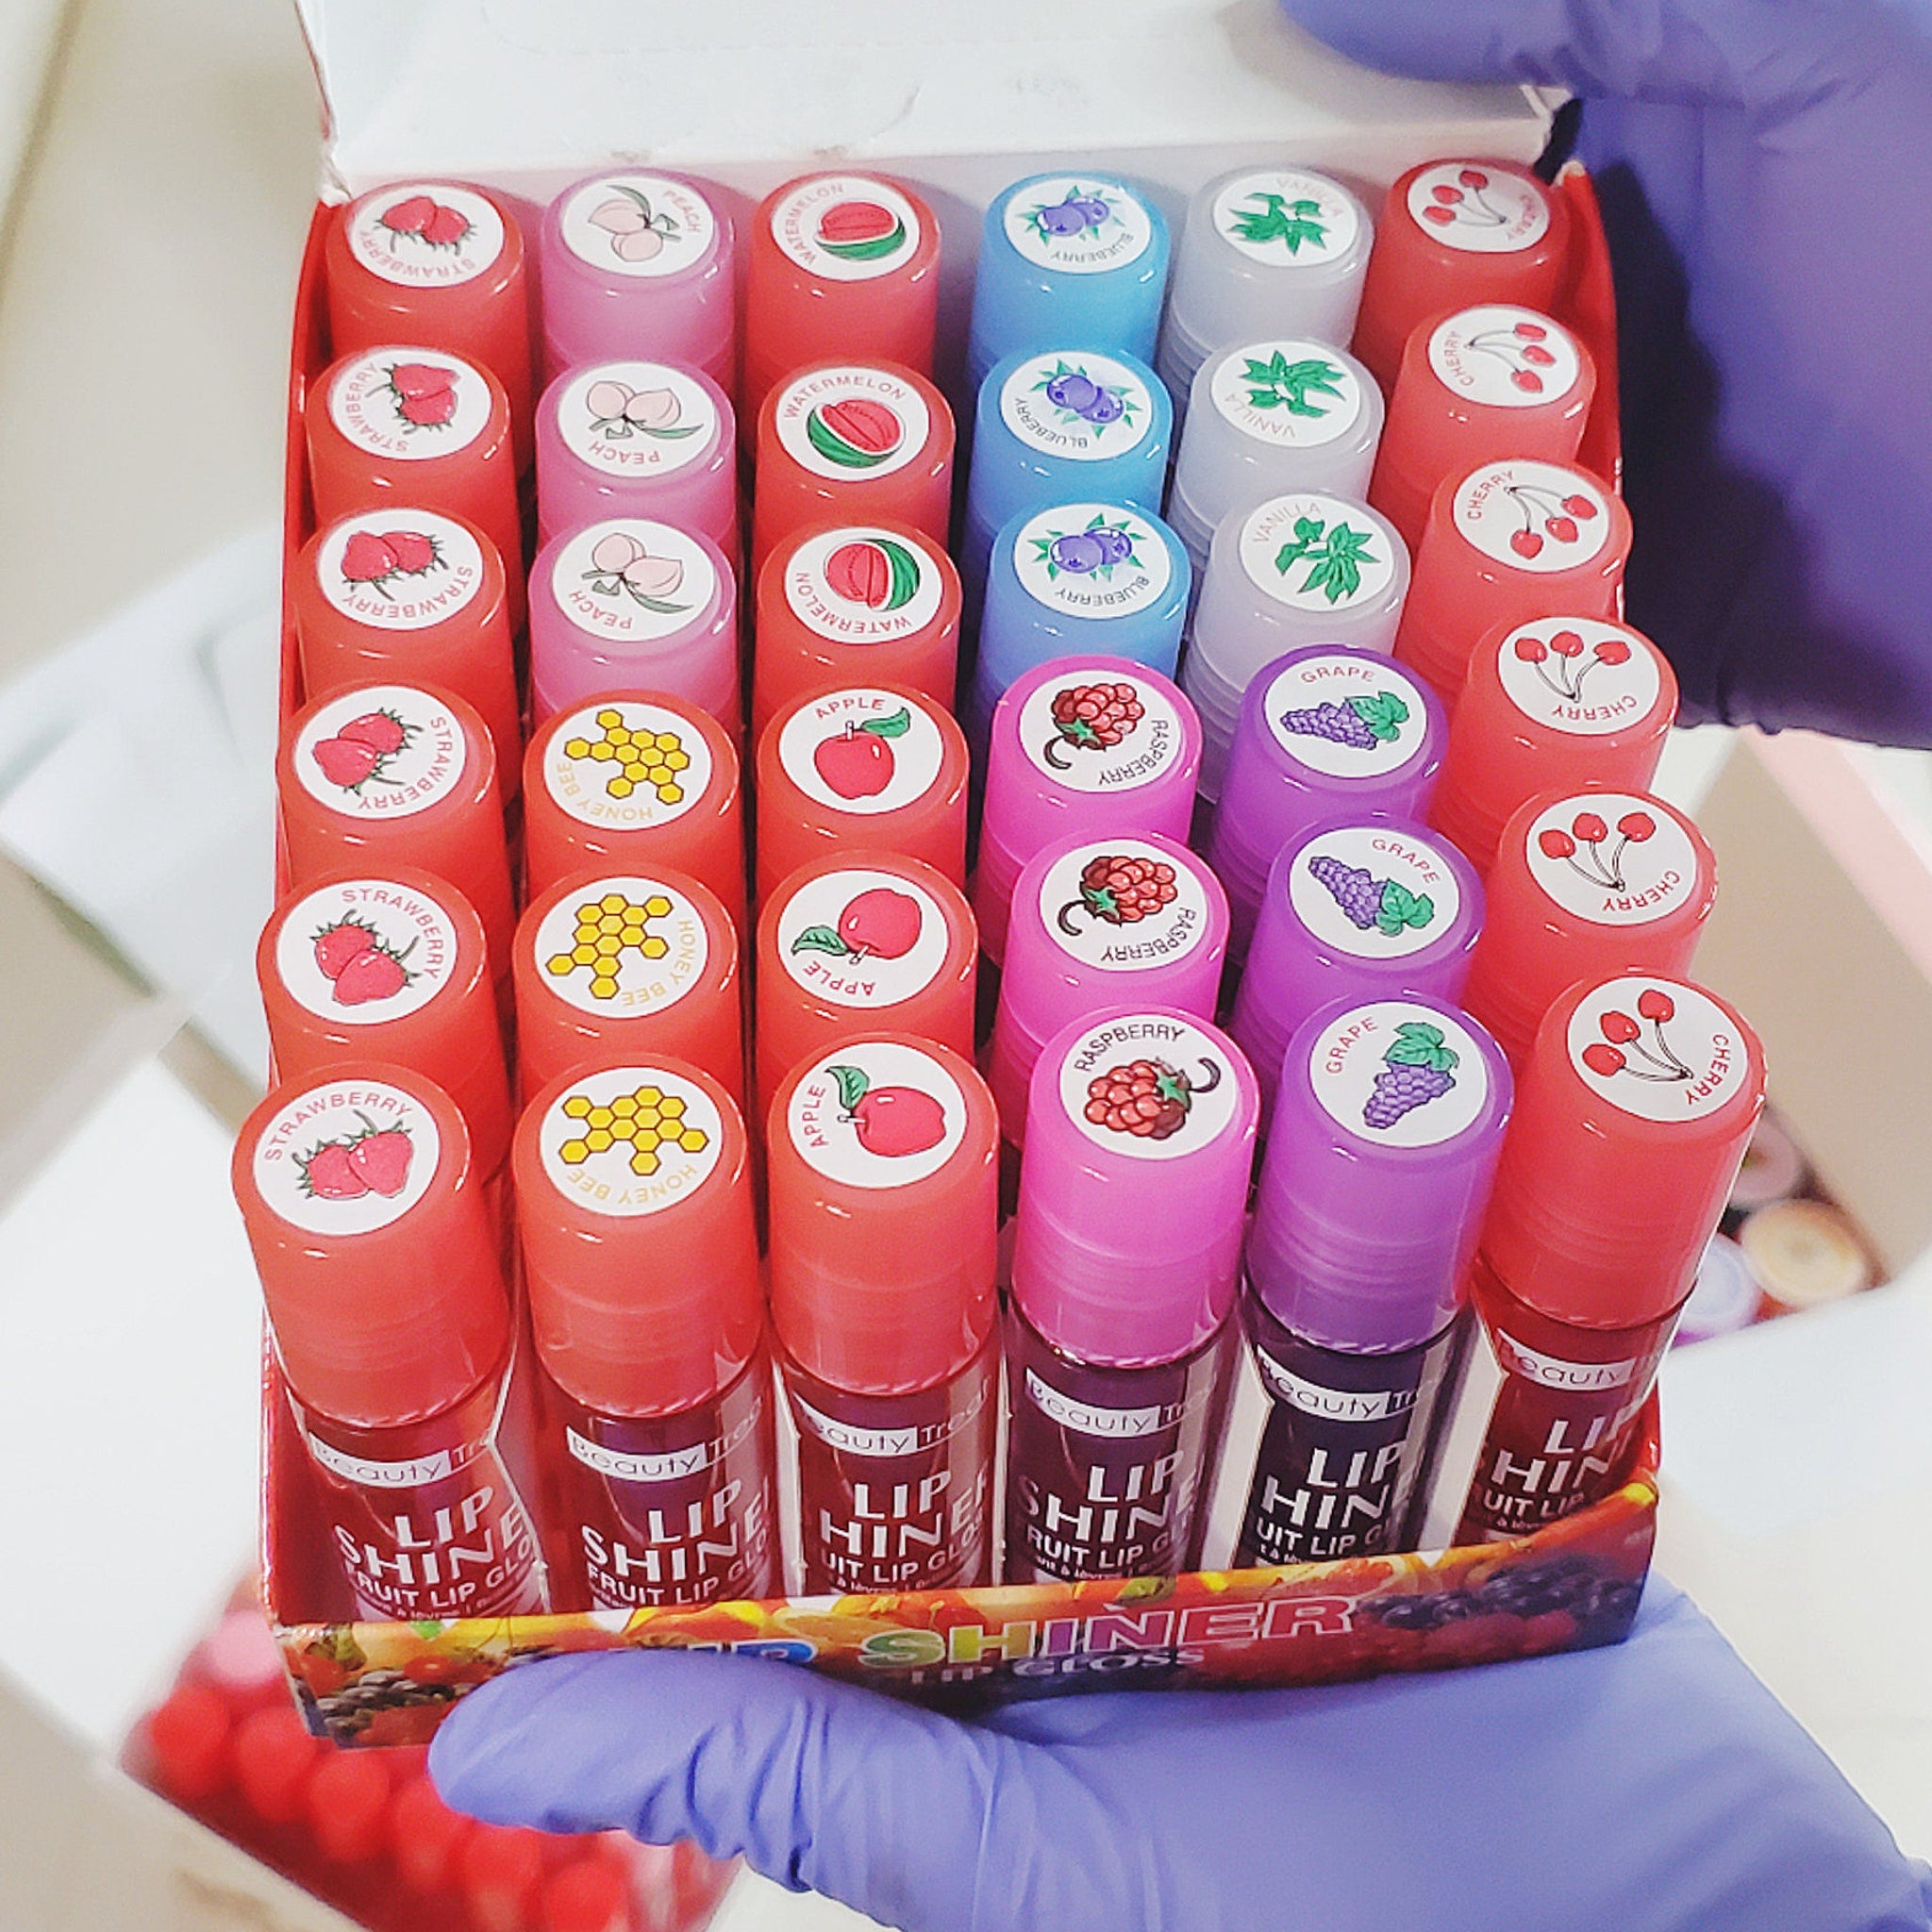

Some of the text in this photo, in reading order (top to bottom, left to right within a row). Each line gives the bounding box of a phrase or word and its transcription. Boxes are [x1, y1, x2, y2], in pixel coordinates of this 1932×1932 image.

[663, 189, 701, 234] PEACH
[786, 183, 844, 267] WATERMELON
[1505, 193, 1537, 242] CHERRY
[360, 231, 477, 279] STRAWBERRY
[1050, 234, 1134, 262] BLUEBERRY
[1443, 329, 1474, 388] CHERRY
[345, 361, 411, 454] STRAWBERRY
[783, 375, 906, 419] WATERMELON
[1014, 396, 1088, 448] BLUEBERRY
[1224, 393, 1297, 439] VANILLA
[589, 441, 660, 465] PEACH
[1467, 470, 1516, 521] CHERRY
[1253, 502, 1322, 542] VANILLA
[341, 565, 473, 621] STRAWBERRY
[570, 587, 633, 630] PEACH
[794, 571, 911, 636] WATERMELON
[1055, 575, 1151, 606] BLUEBERRY
[1301, 665, 1374, 684] GRAPE
[814, 698, 885, 720] APPLE
[1552, 694, 1638, 722] CHERRY
[358, 716, 452, 810] STRAWBERRY
[1098, 719, 1170, 787] RASPBERRY
[557, 761, 653, 820] HONEY BEE
[1371, 837, 1441, 885] GRAPE
[1601, 870, 1680, 911] CHERRY
[341, 888, 442, 980] STRAWBERRY
[1101, 906, 1196, 962] RASPBERRY
[622, 919, 691, 1007] HONEY BEE
[804, 962, 877, 996] APPLE
[1074, 1019, 1186, 1074] RASPBERRY
[1326, 1017, 1379, 1074] GRAPE
[1684, 1033, 1731, 1107] CHERRY
[265, 1091, 412, 1159] STRAWBERRY
[800, 1084, 827, 1148] APPLE
[568, 1163, 697, 1205] HONEY BEE
[1029, 1378, 1151, 1433] Beauty
[572, 1436, 700, 1476] Beauty
[809, 1413, 909, 1454] eauty
[1088, 1450, 1185, 1503] LIP
[1307, 1441, 1407, 1489] LIP
[394, 1486, 493, 1547] LIP
[648, 1478, 741, 1544] LIP
[854, 1470, 951, 1520] LIP
[334, 1505, 525, 1585] SHINE
[587, 1561, 664, 1606] FRUIT
[675, 1576, 719, 1605] LIP
[728, 1528, 767, 1582] GLO
[1027, 1524, 1091, 1568] RUIT
[1098, 1543, 1144, 1569] LIP
[1310, 1535, 1357, 1556] LIP
[430, 1582, 475, 1607] LIP
[486, 1535, 531, 1588] GLO
[874, 1562, 919, 1584] LIP
[858, 1595, 1357, 1668] SHINER
[1013, 1648, 1204, 1677] GLOSS
